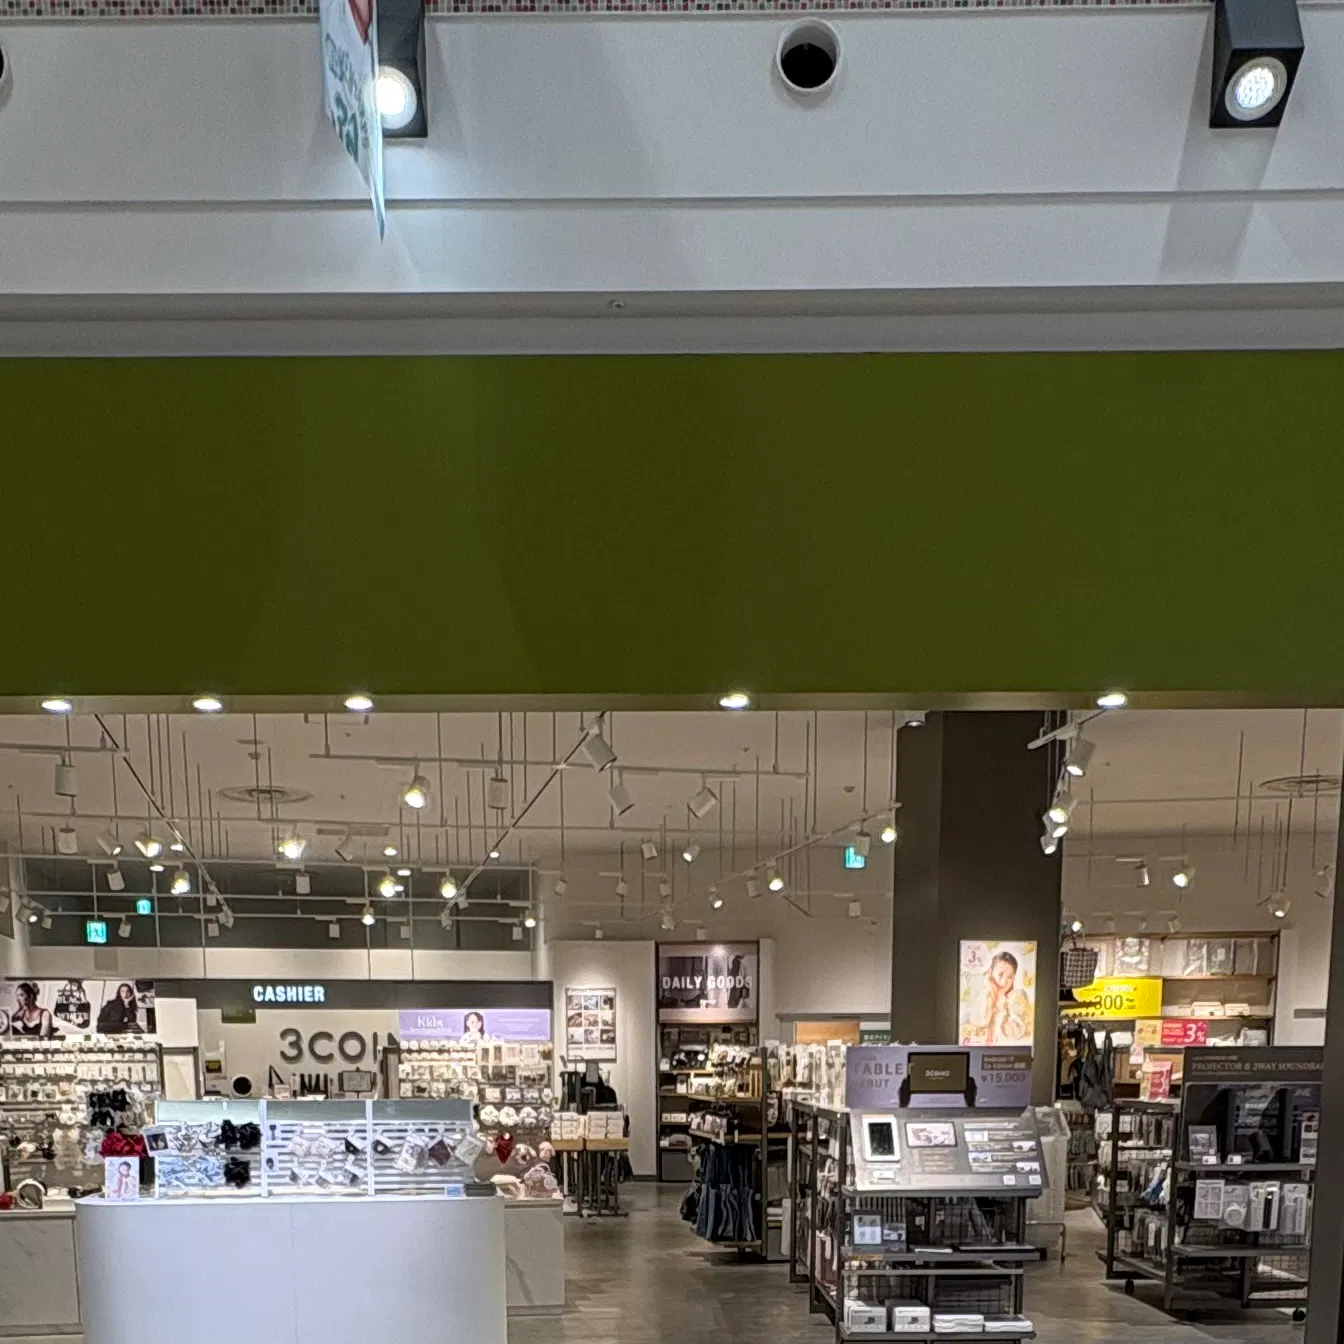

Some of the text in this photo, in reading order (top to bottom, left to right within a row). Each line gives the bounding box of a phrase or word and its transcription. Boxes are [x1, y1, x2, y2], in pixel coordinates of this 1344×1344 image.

[662, 975, 753, 989] DAILY GOODS
[253, 985, 325, 1002] CASHIER
[1192, 1061, 1242, 1071] PROJECTOR
